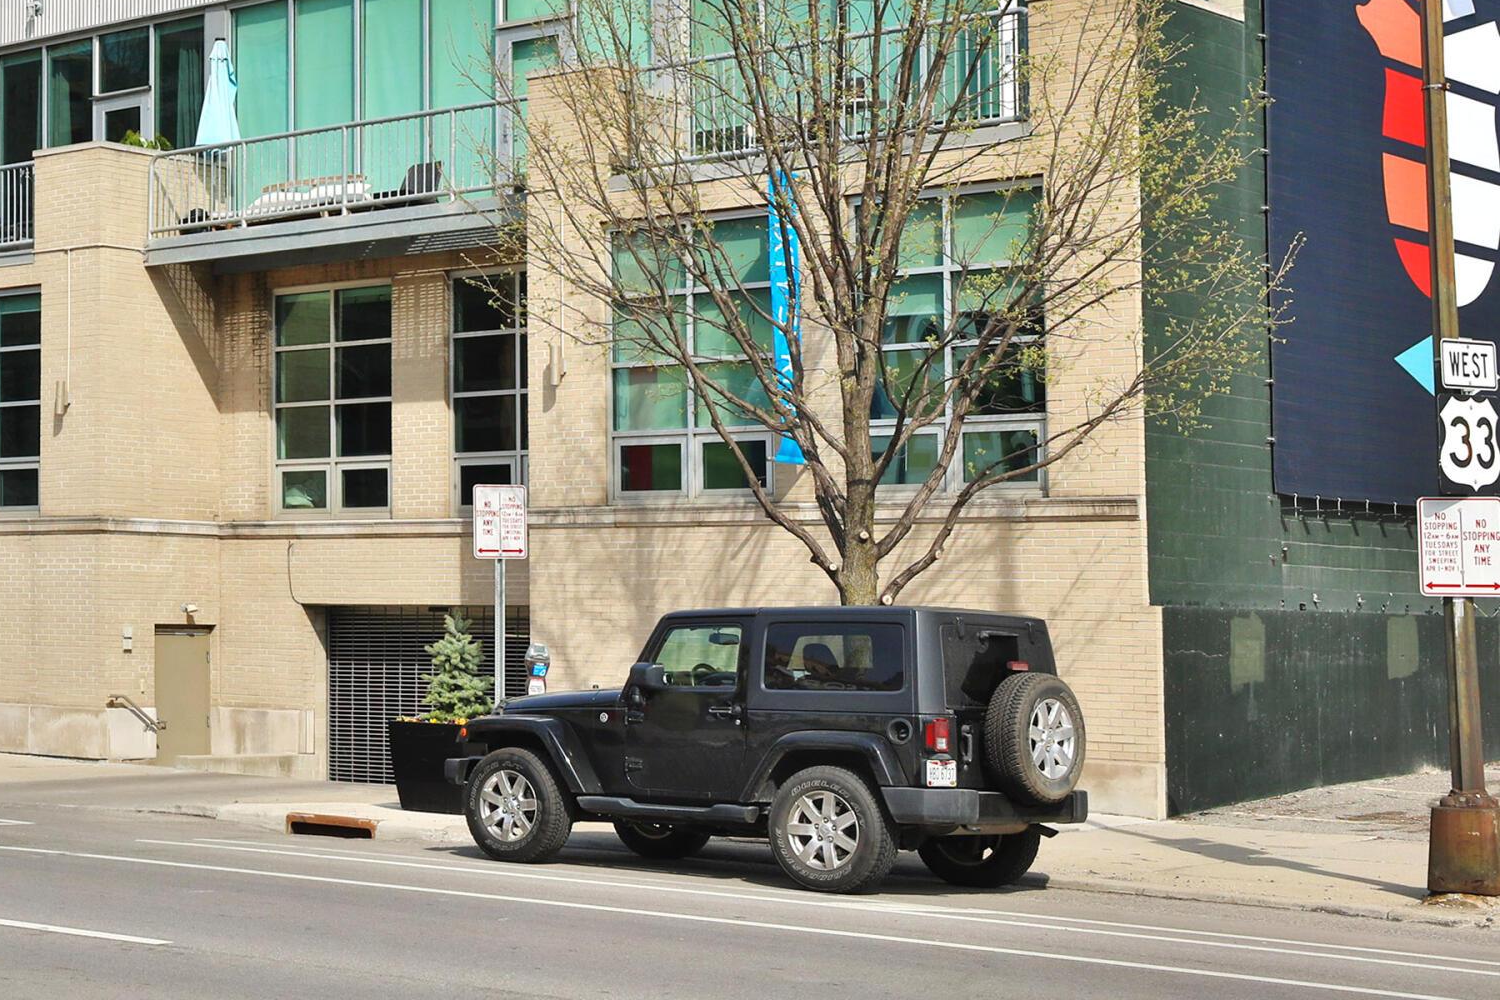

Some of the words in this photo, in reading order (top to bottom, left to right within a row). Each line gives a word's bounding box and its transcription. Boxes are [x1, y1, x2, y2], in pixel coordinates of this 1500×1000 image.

[1449, 350, 1488, 379] WEST
[1449, 416, 1496, 470] 33
[1434, 512, 1447, 520] NO
[1424, 522, 1458, 530] STOPPING
[1475, 519, 1487, 528] NO
[1463, 531, 1500, 541] STOPPING
[1425, 541, 1458, 549] TUESDAYS
[1474, 544, 1491, 553] ANY
[1474, 556, 1492, 566] TIME
